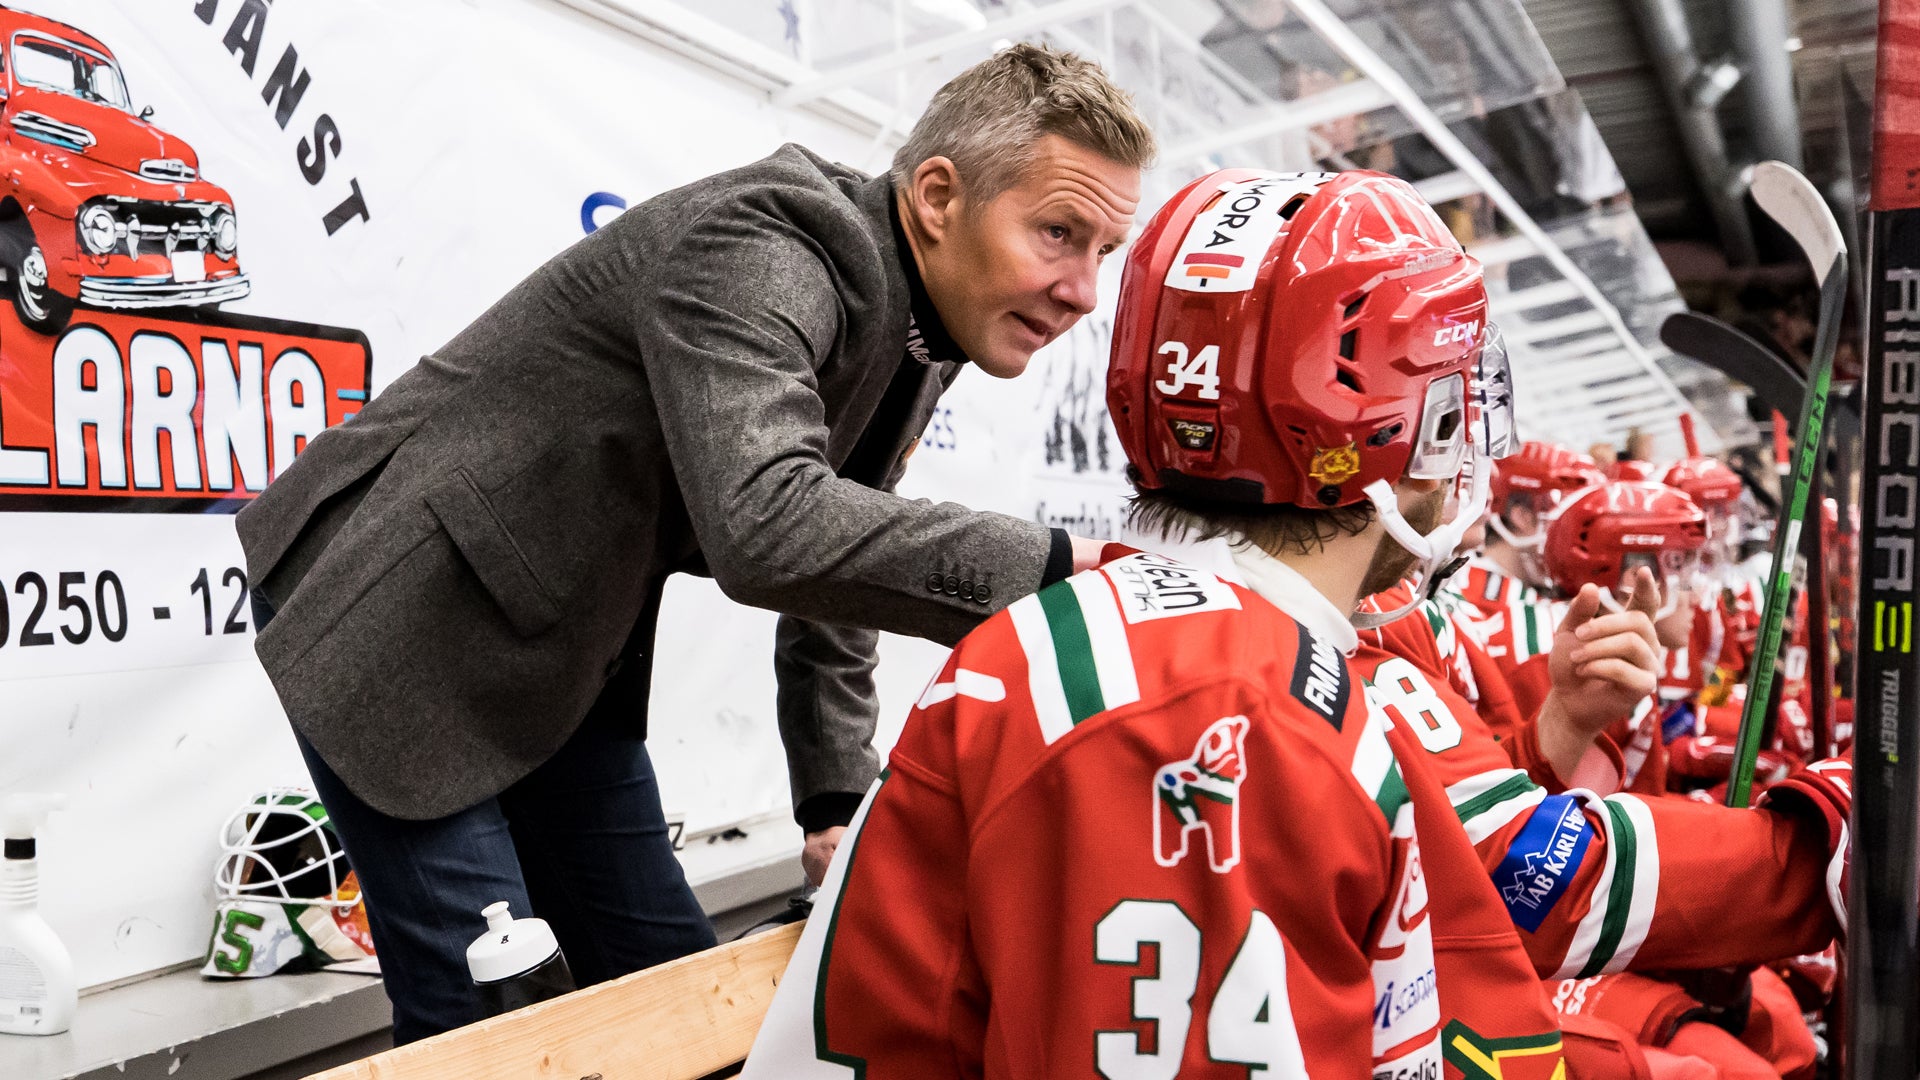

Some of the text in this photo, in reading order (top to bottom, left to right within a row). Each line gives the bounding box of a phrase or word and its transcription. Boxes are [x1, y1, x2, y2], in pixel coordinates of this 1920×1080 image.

[1205, 184, 1274, 248] MORA
[1433, 319, 1479, 346] CCM
[1155, 341, 1220, 400] 34
[0, 322, 327, 491] ARNA
[1527, 873, 1555, 903] AB
[1543, 833, 1579, 877] KARL
[1094, 898, 1310, 1080] 34
